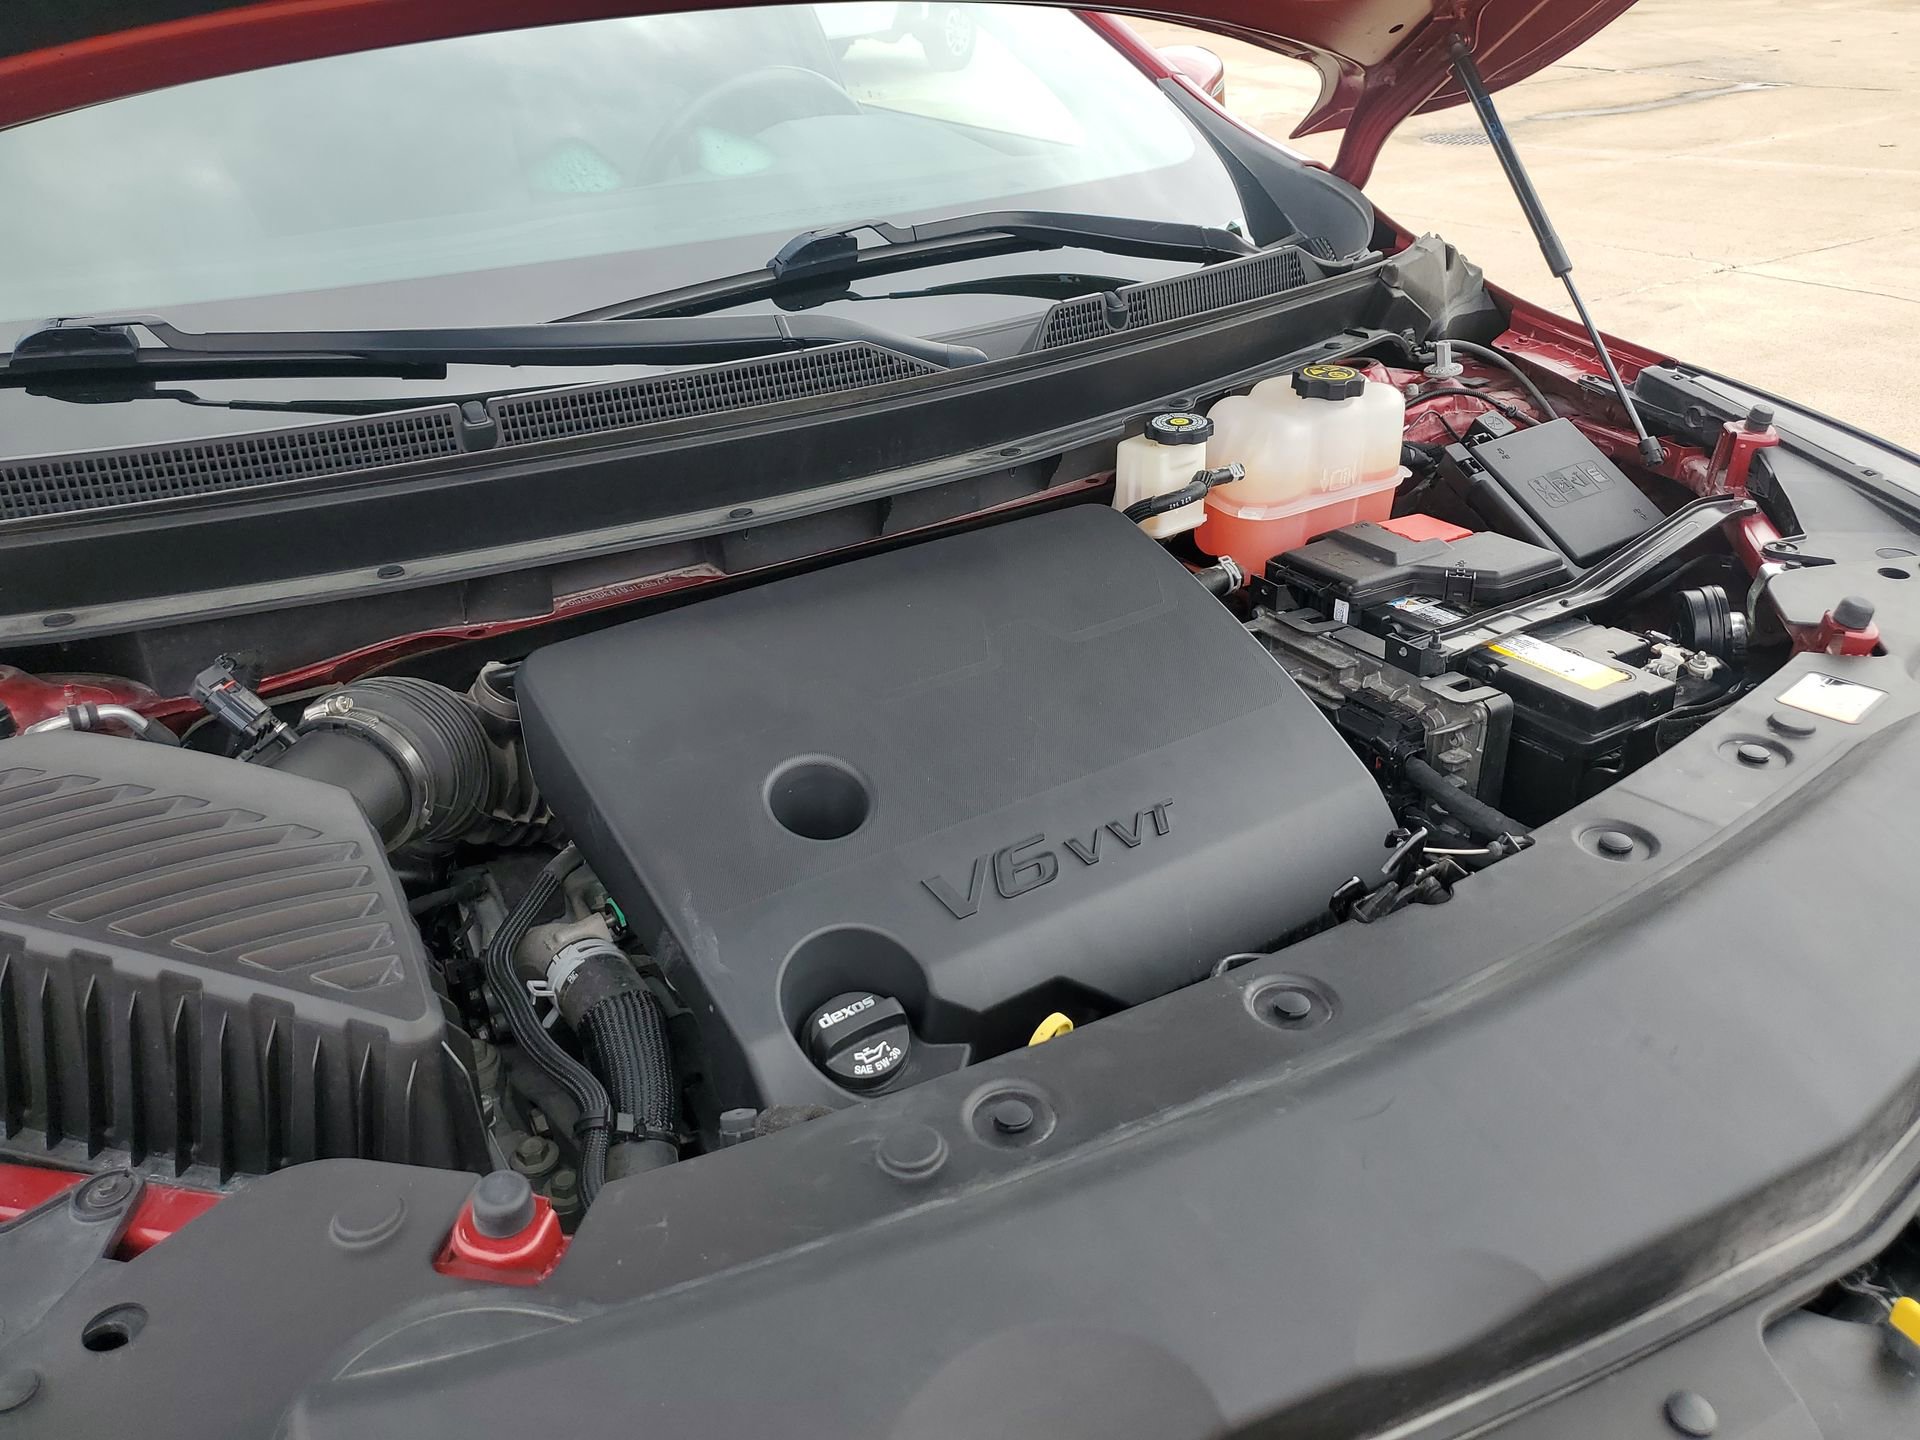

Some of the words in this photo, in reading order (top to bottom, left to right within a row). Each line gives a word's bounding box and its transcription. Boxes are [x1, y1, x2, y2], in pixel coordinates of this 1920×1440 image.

[921, 833, 1059, 920] V6
[1063, 798, 1174, 865] VVT
[818, 995, 875, 1029] dexos
[854, 1063, 874, 1075] SAE
[875, 1047, 901, 1072] 5W-30
